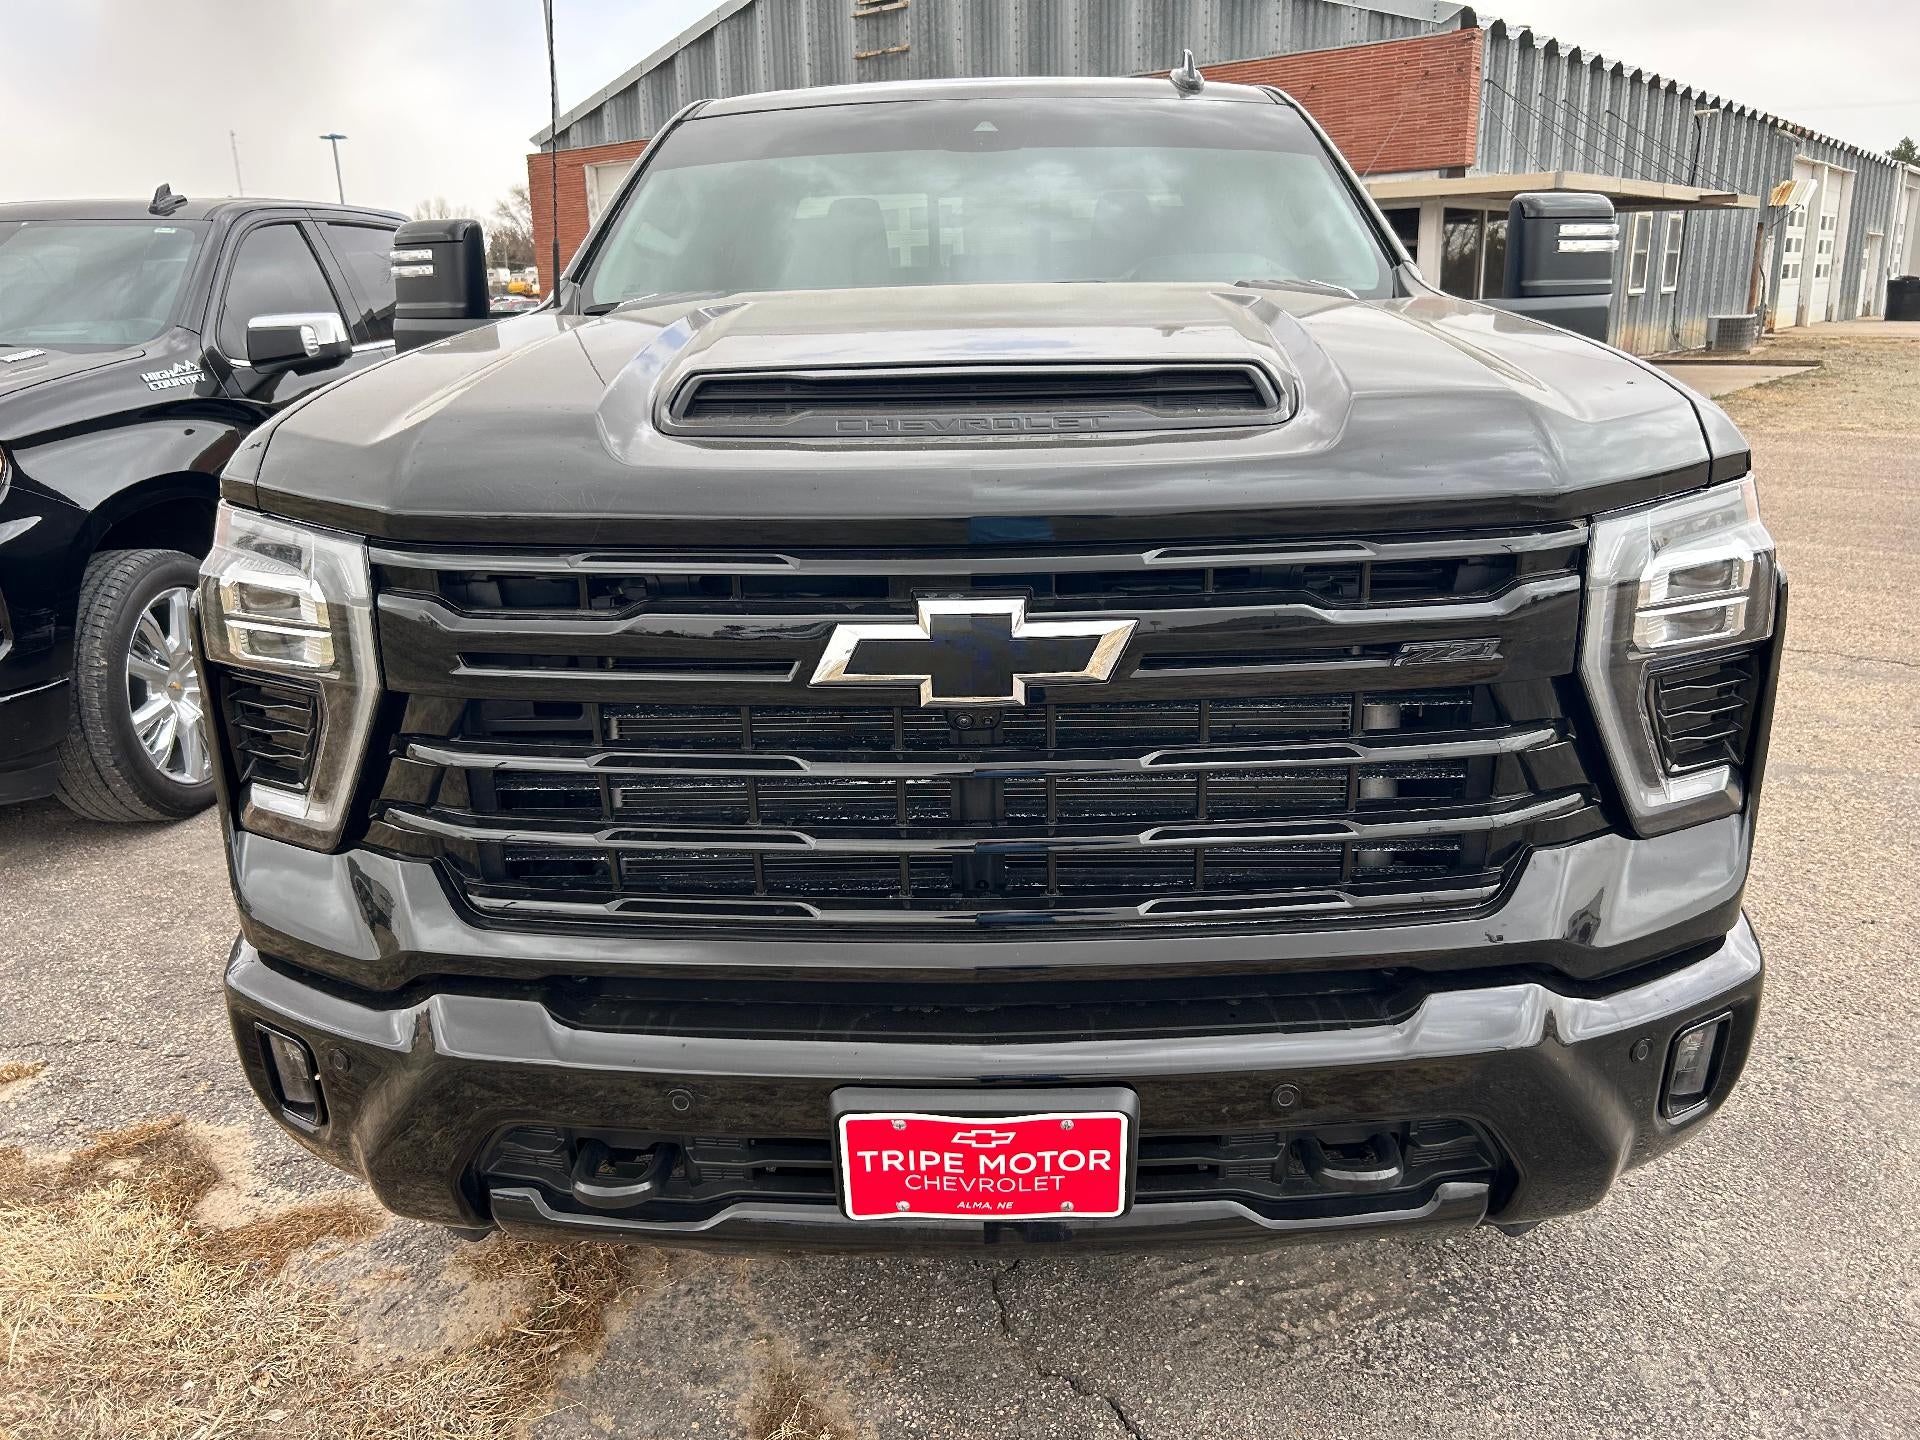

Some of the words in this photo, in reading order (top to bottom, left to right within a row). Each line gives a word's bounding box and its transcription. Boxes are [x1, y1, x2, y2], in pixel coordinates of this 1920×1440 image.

[141, 369, 175, 382] HIGH
[148, 373, 206, 391] COUNTRY
[835, 415, 1110, 432] CHEVROLET
[1393, 638, 1504, 667] Z71
[857, 1150, 965, 1174] TRIPE
[979, 1150, 1112, 1175] MOTOR
[904, 1174, 1066, 1193] CHEVROLET
[956, 1201, 992, 1210] ALMA,
[997, 1201, 1014, 1210] NE
